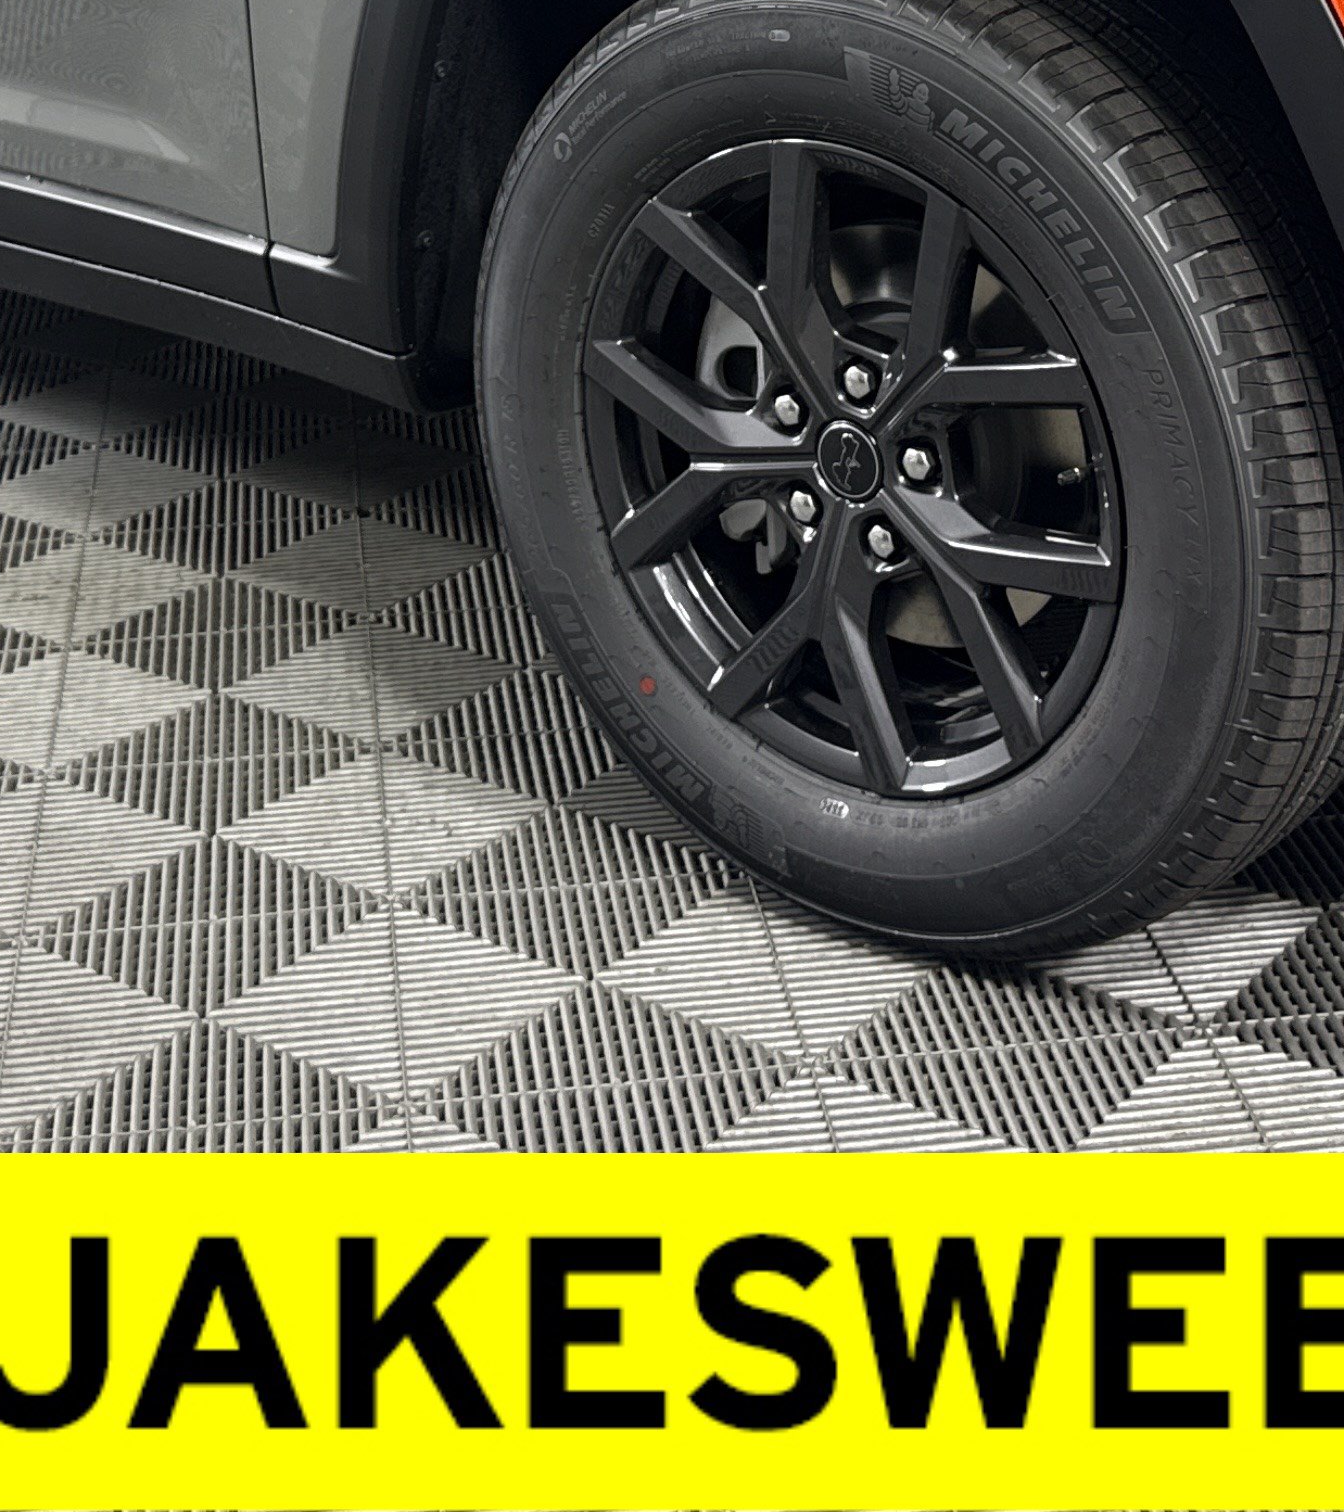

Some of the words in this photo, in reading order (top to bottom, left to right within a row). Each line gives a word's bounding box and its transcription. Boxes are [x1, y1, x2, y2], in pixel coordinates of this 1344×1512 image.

[939, 108, 1137, 321] MICHELIN
[1141, 368, 1200, 527] PRIMACY
[550, 603, 706, 803] MICHELIN
